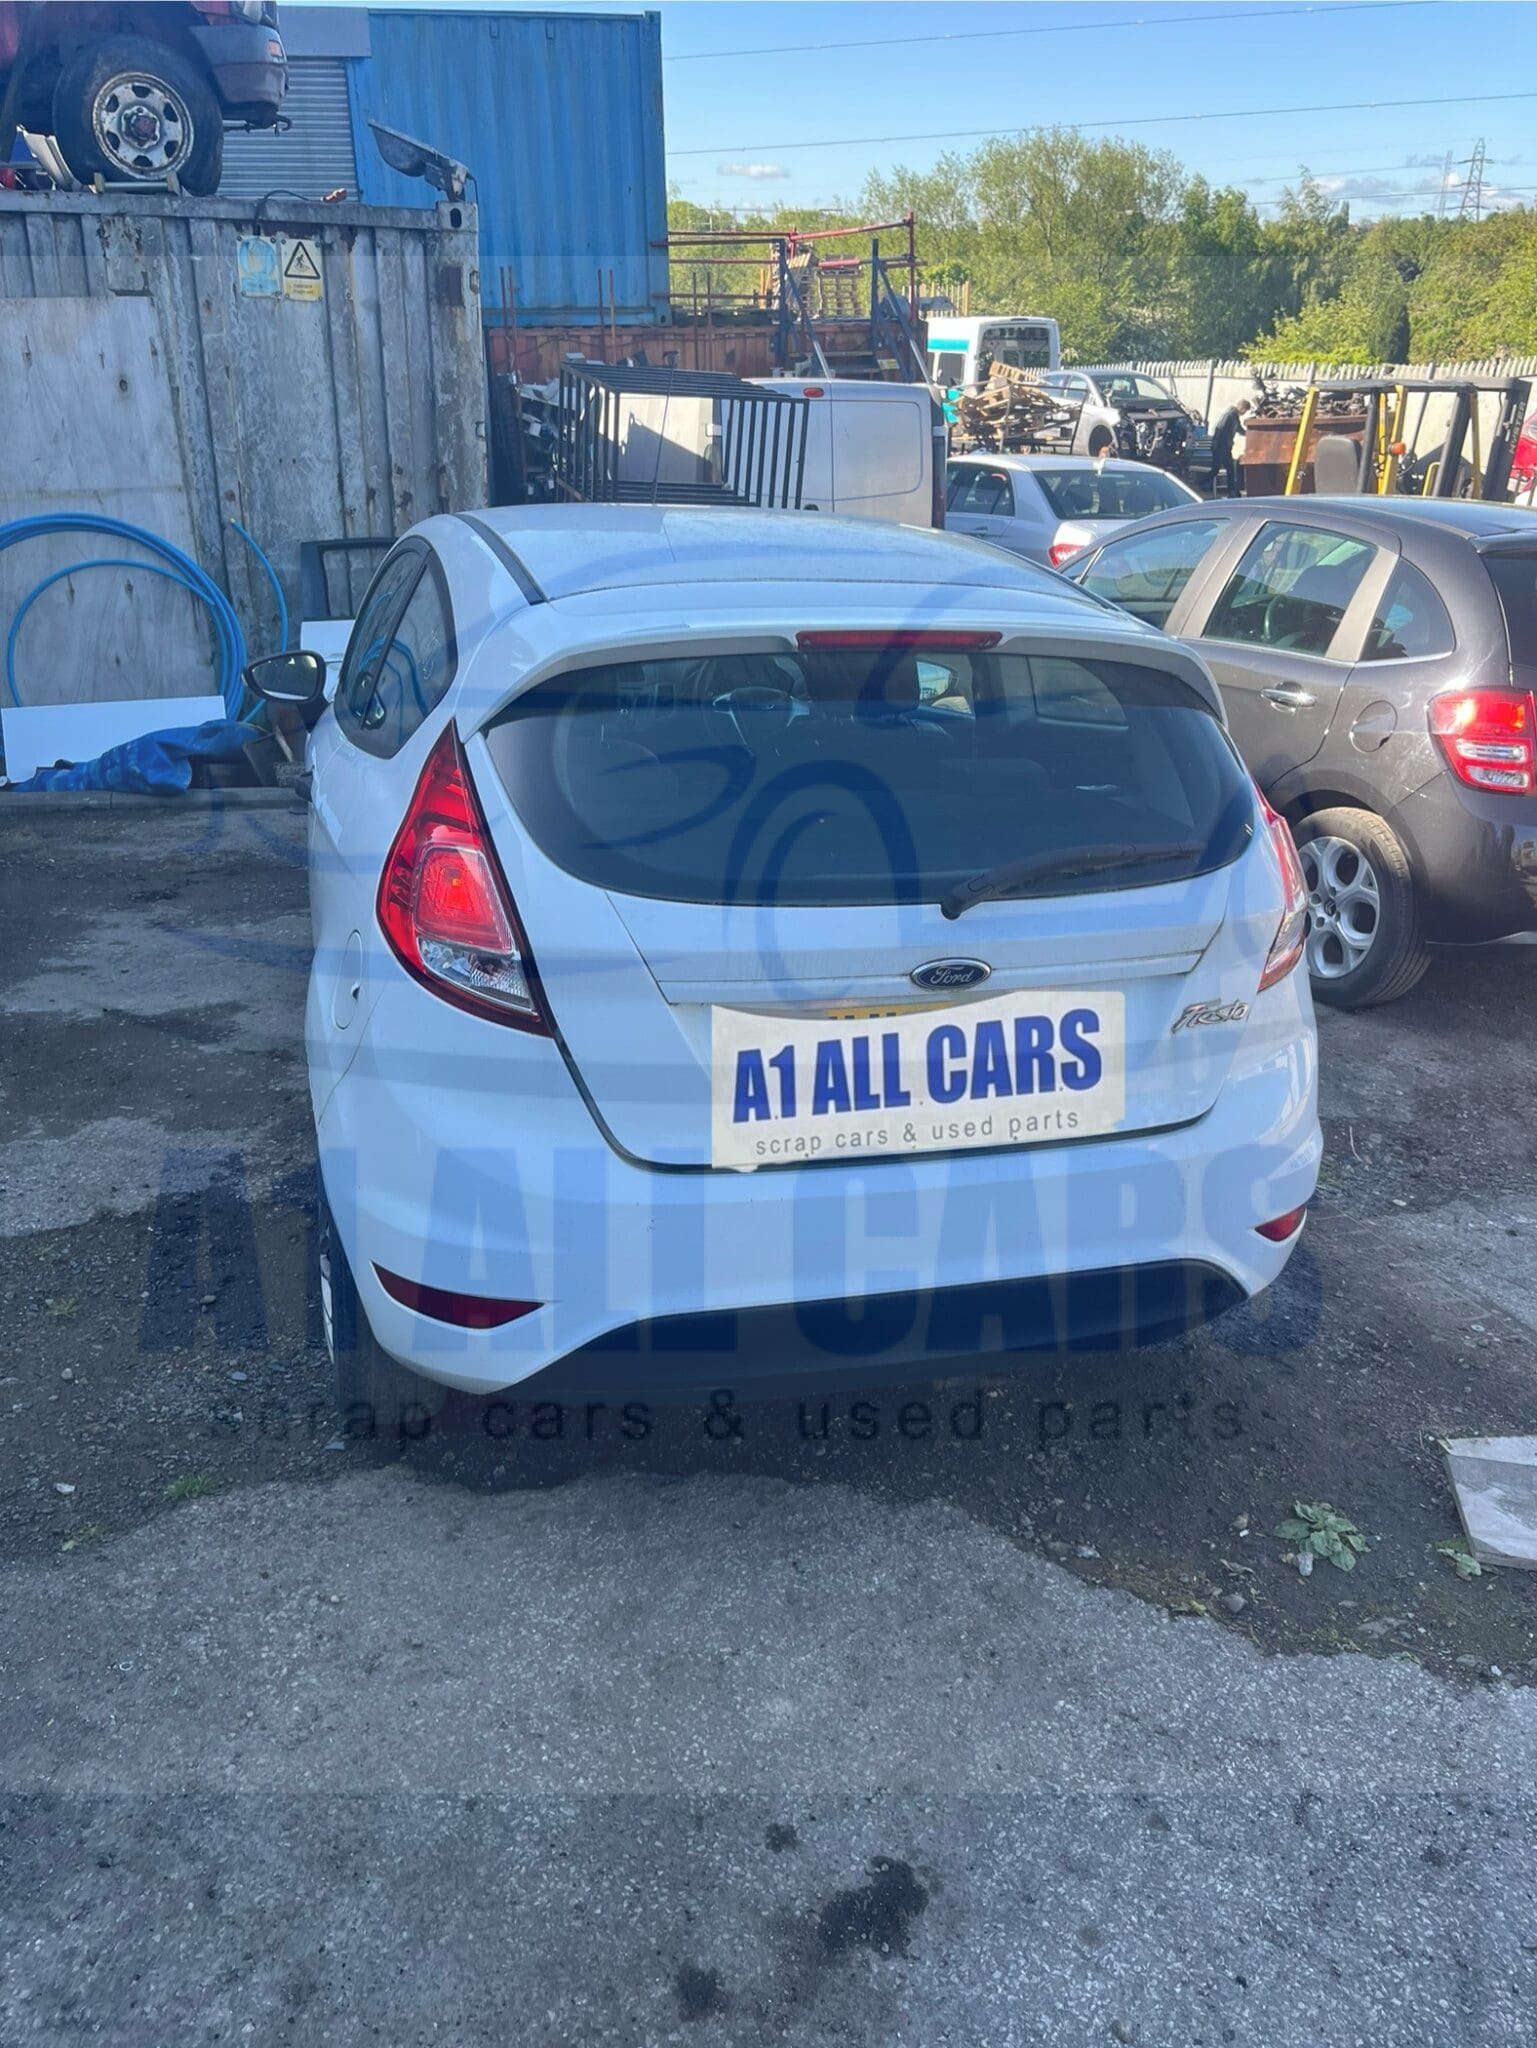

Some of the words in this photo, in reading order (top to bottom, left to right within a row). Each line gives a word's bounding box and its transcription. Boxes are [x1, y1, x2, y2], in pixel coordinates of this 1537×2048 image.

[930, 965, 975, 985] Ford
[1170, 999, 1249, 1033] Fiesta
[733, 1045, 797, 1124] A1
[812, 1032, 912, 1117] ALL
[926, 1008, 1102, 1105] CARS
[756, 1135, 821, 1155] scrap
[835, 1129, 888, 1148] cars
[903, 1122, 917, 1143] &
[932, 1115, 993, 1141] used
[1009, 1109, 1079, 1138] parts
